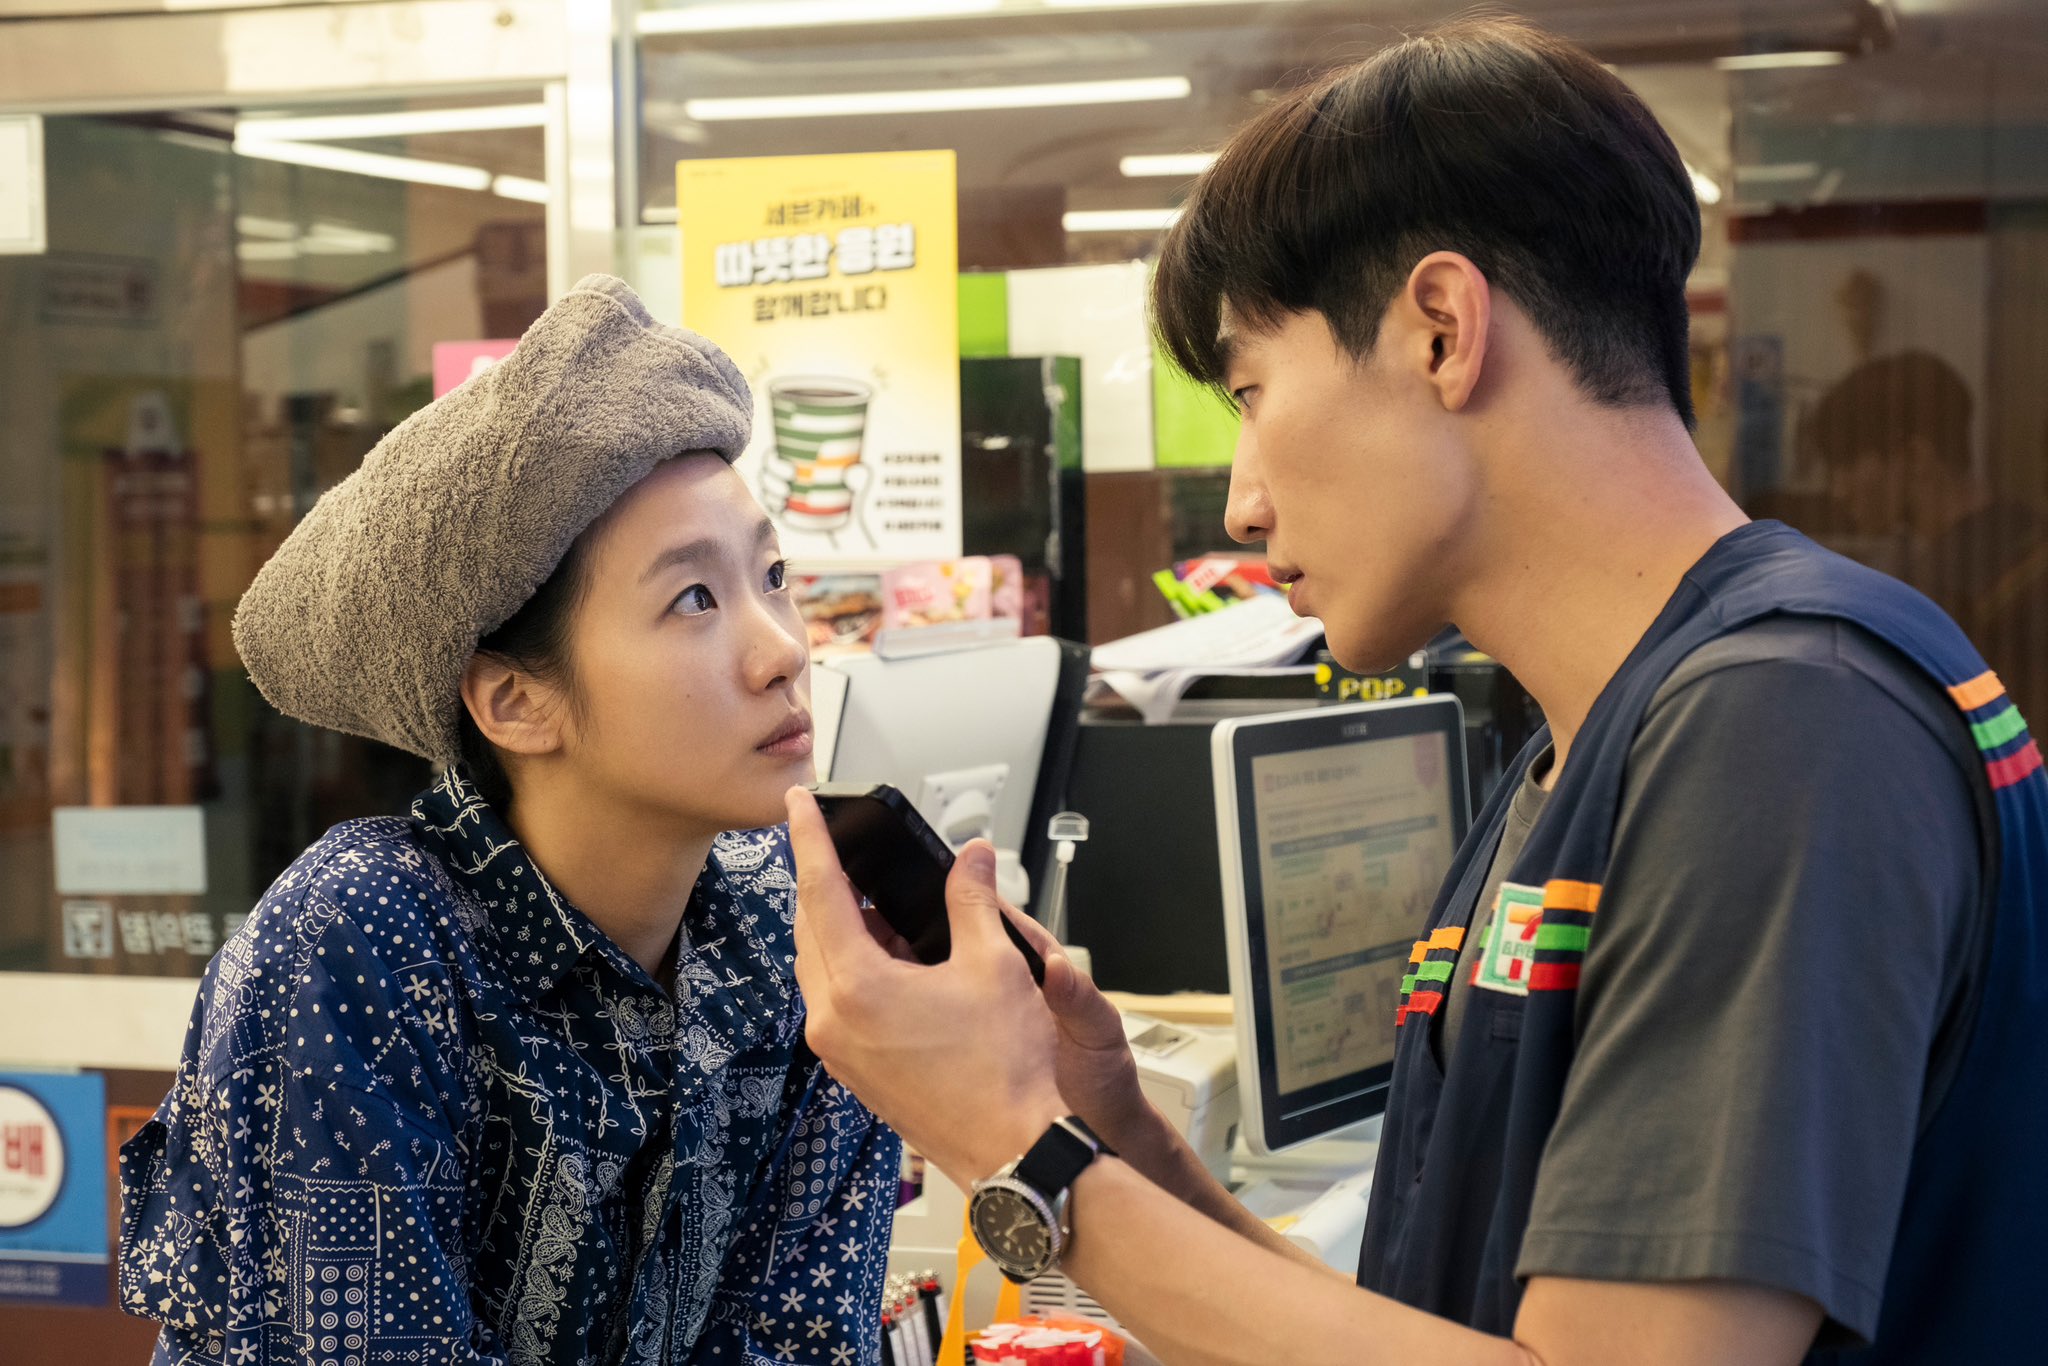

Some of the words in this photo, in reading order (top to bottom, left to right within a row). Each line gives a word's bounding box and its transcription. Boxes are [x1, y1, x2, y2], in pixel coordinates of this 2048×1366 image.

[716, 238, 830, 288] 따뜻한
[837, 222, 916, 275] 응원
[755, 287, 887, 321] 함께합니다
[1339, 677, 1406, 701] POP
